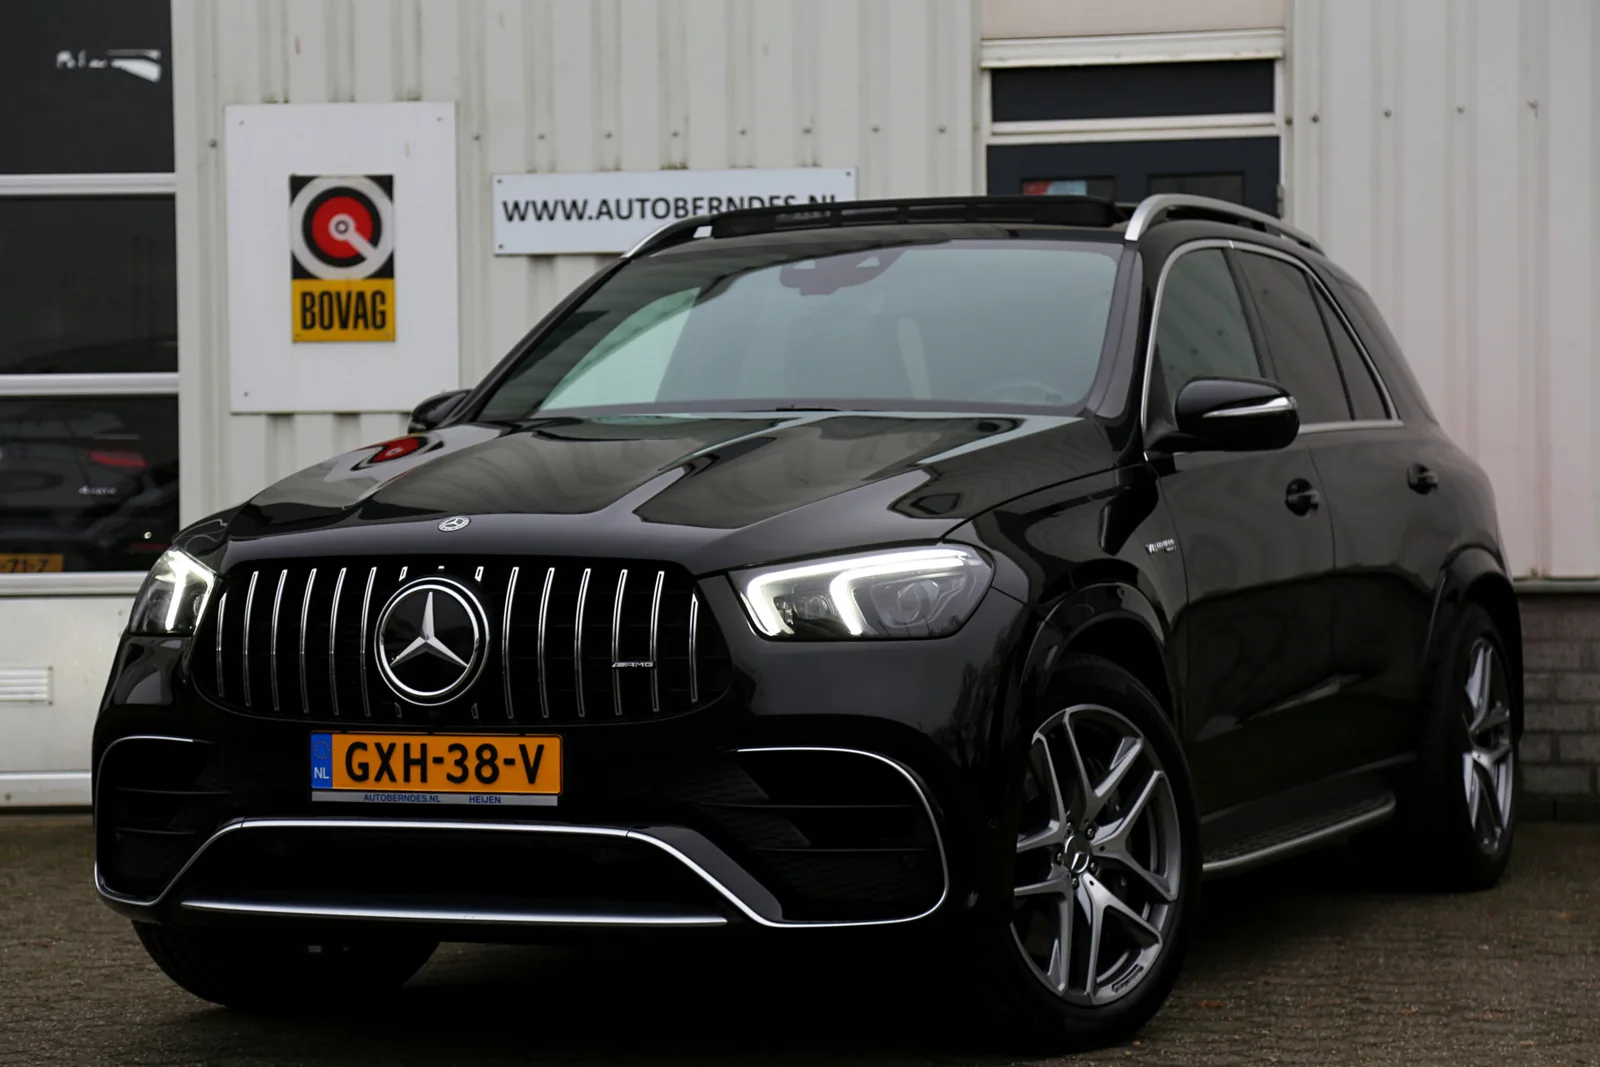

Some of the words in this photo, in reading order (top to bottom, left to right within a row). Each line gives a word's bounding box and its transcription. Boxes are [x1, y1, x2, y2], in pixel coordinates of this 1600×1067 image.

[502, 194, 837, 221] WWW.AUTOBERNDES
[301, 290, 387, 331] BOVAG
[314, 766, 330, 780] NL
[345, 741, 545, 784] GXH-38-V
[364, 793, 441, 803] AUTOBERNDES.NL
[469, 795, 501, 804] HEIJEN
